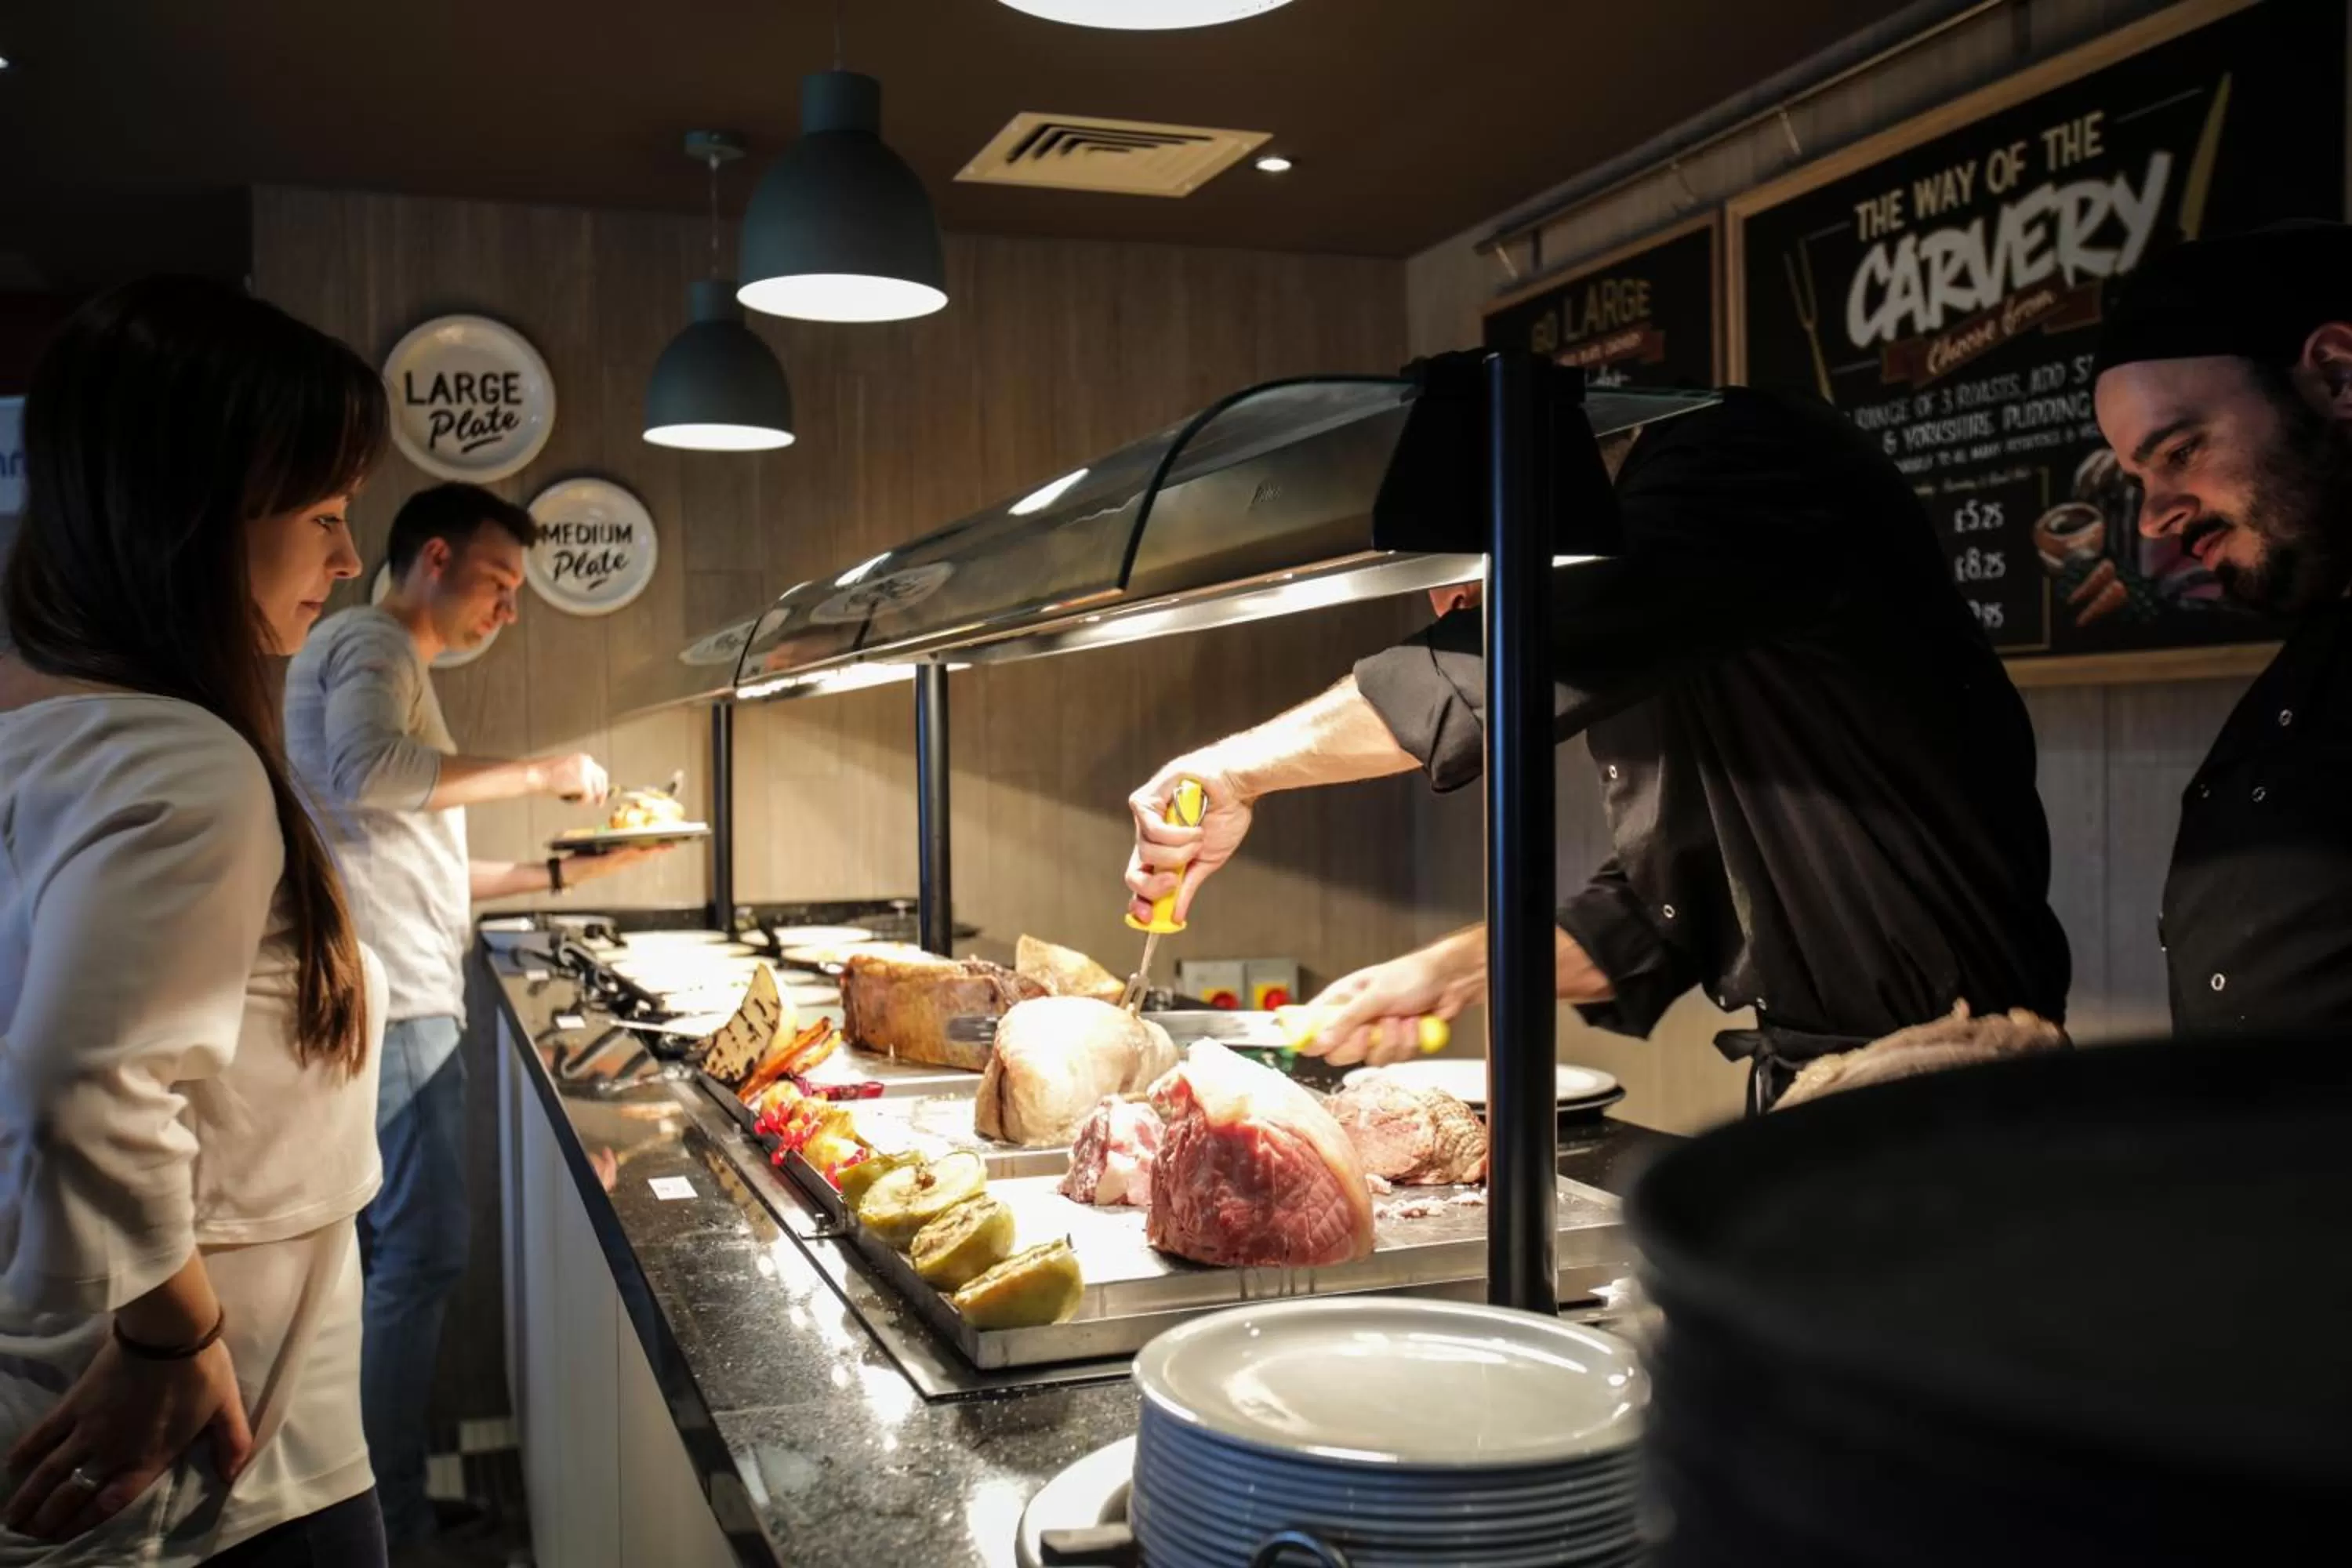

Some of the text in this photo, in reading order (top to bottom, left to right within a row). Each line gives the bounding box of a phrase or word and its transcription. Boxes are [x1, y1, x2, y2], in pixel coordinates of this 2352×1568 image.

[1855, 111, 2104, 241] THE WAY OF THE
[1847, 150, 2172, 347] CARVERY
[1563, 278, 1651, 342] LARGE
[1926, 289, 2058, 375] Choose from
[405, 371, 523, 405] LARGE
[1913, 391, 1938, 419] OF
[428, 408, 521, 452] Plate
[1902, 409, 1995, 452] YORKSHIRE
[2001, 390, 2092, 433] PUDDING
[540, 524, 633, 544] MEDIUM
[554, 550, 629, 582] Plate
